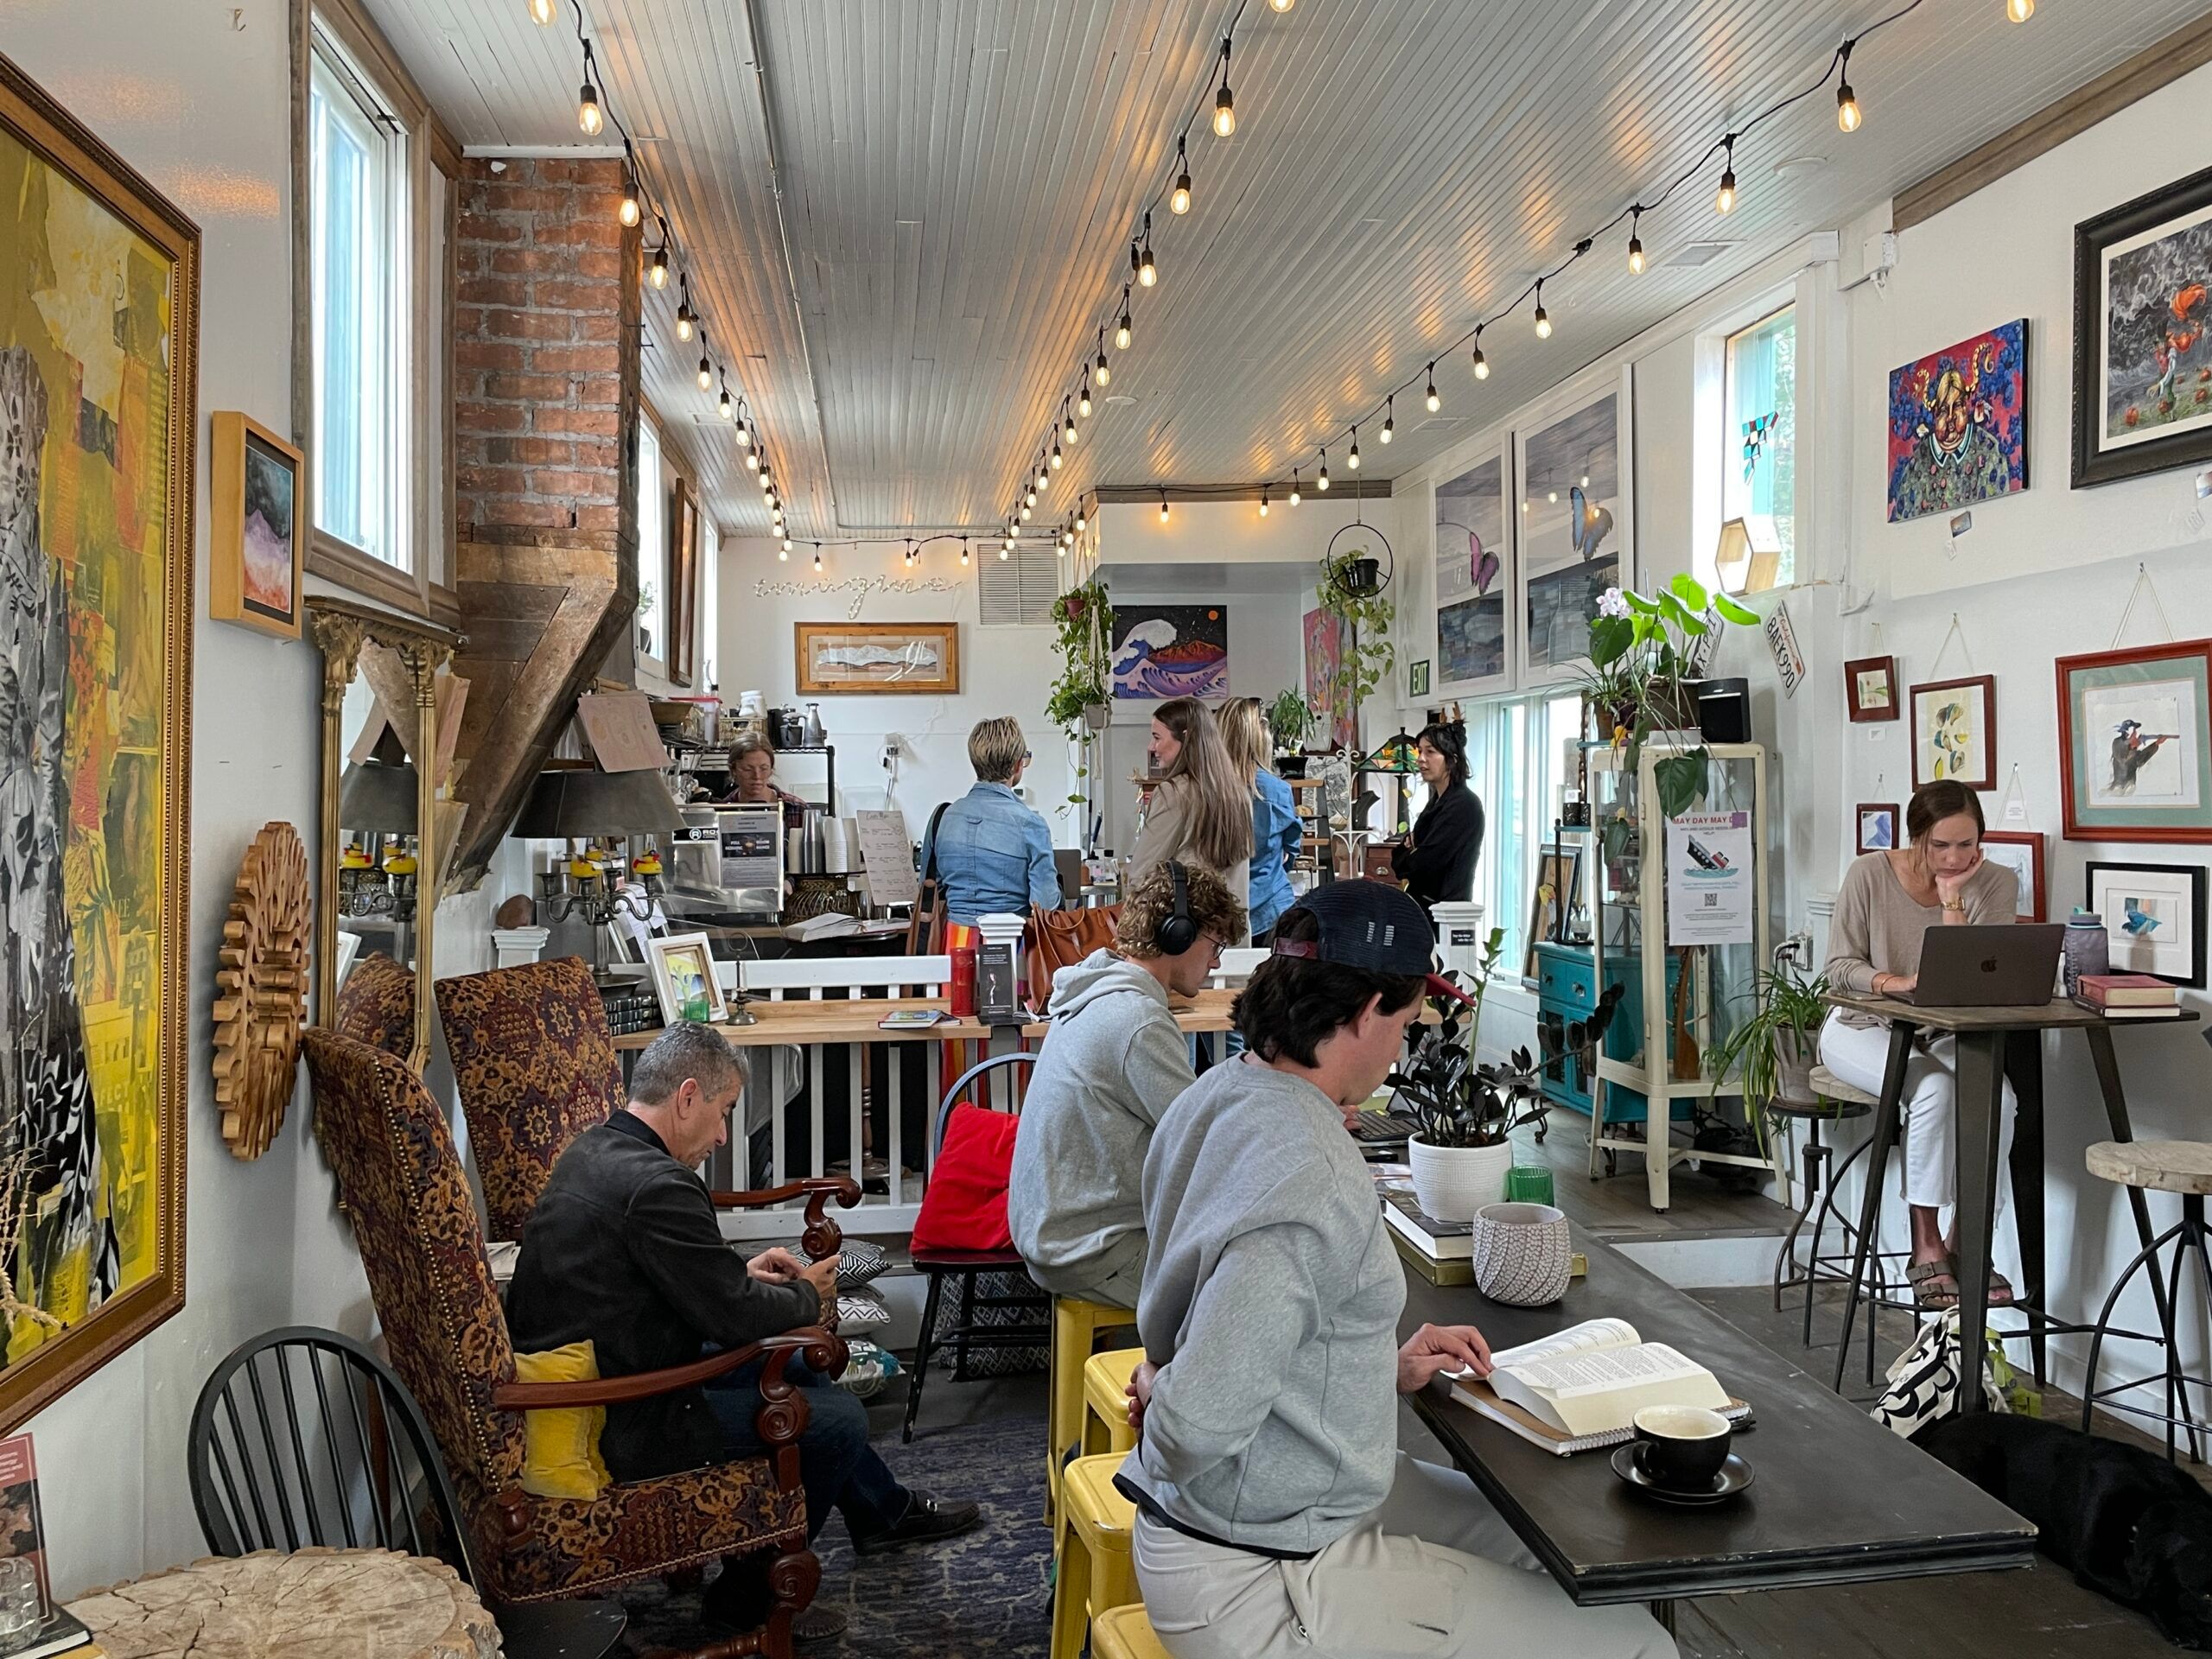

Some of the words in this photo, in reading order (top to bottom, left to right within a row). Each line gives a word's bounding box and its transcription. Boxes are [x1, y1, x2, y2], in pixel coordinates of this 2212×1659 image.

[753, 574, 963, 620] imagine
[1767, 616, 1795, 689] 8AEK990
[1413, 663, 1427, 694] EXIT
